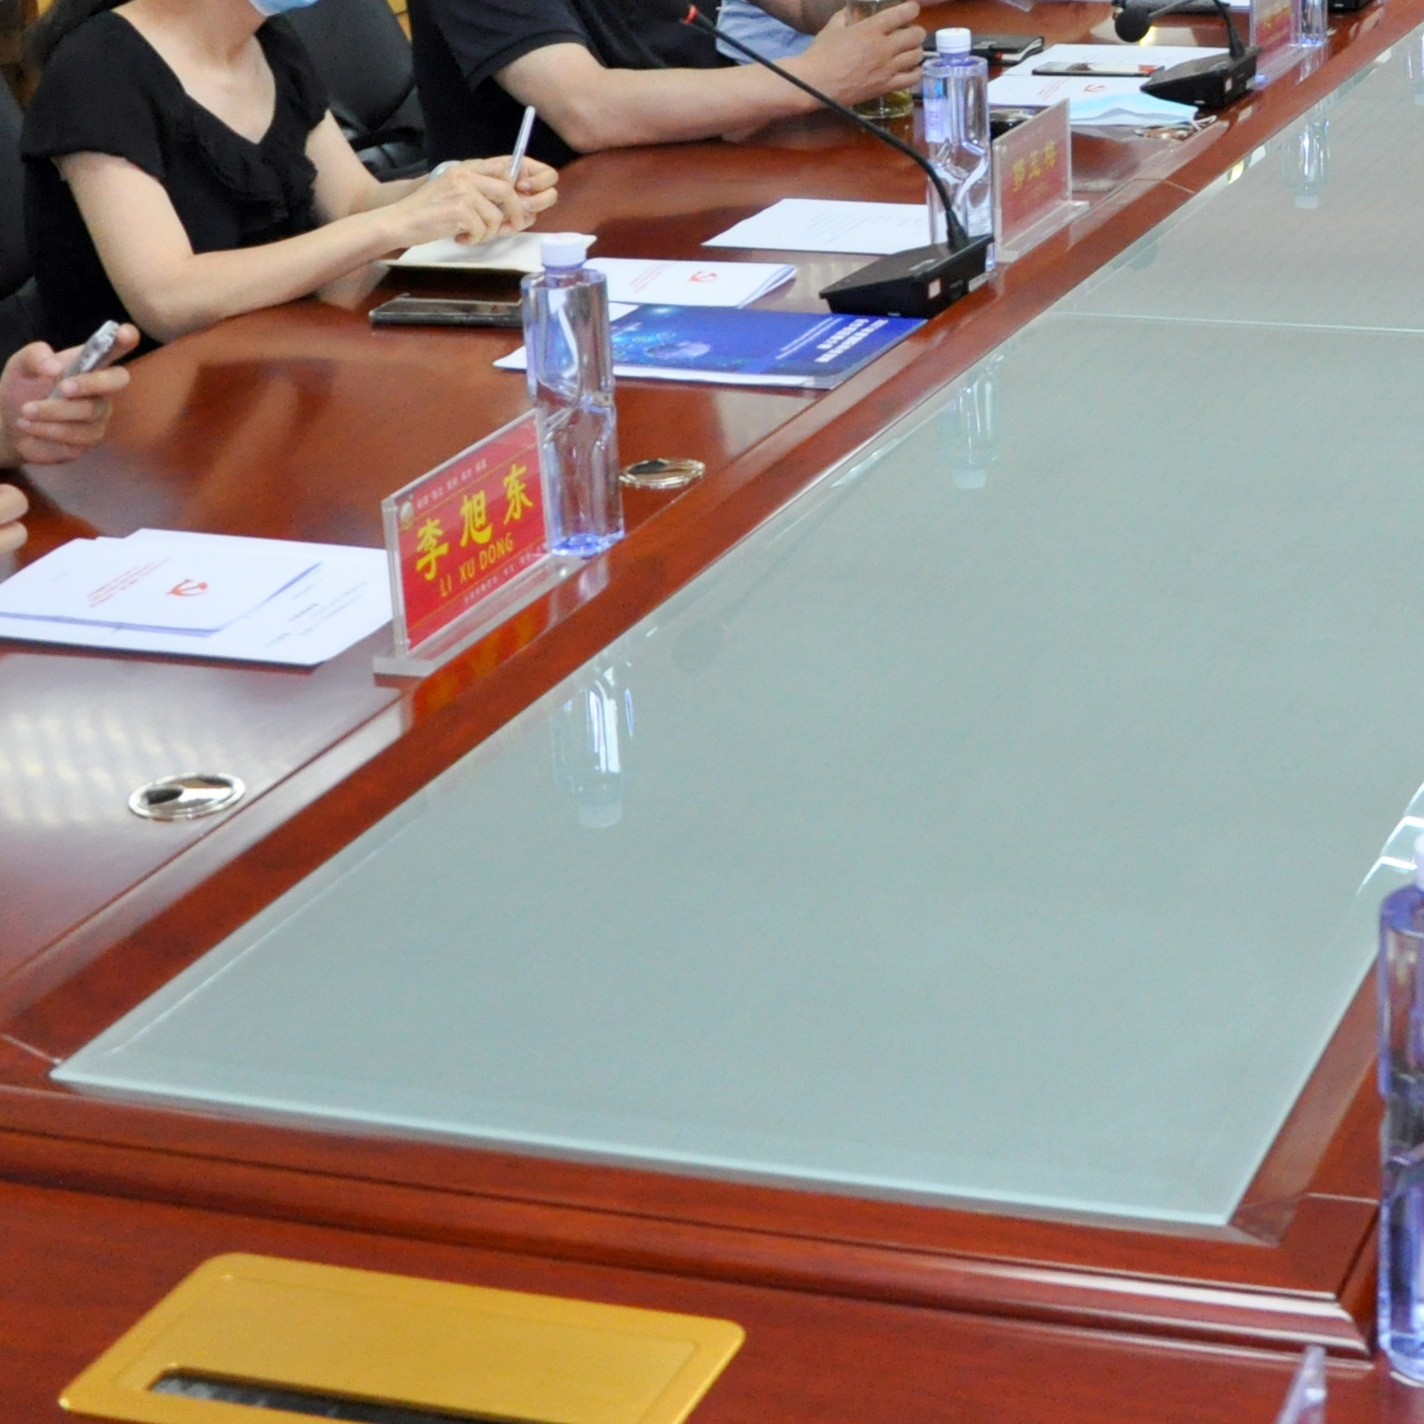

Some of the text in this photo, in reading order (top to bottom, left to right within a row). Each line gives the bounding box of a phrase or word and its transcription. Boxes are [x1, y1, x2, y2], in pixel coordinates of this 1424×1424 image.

[415, 462, 534, 582] 李旭东
[439, 575, 452, 598] LI
[458, 559, 476, 585] XU
[479, 531, 515, 572] DONG
